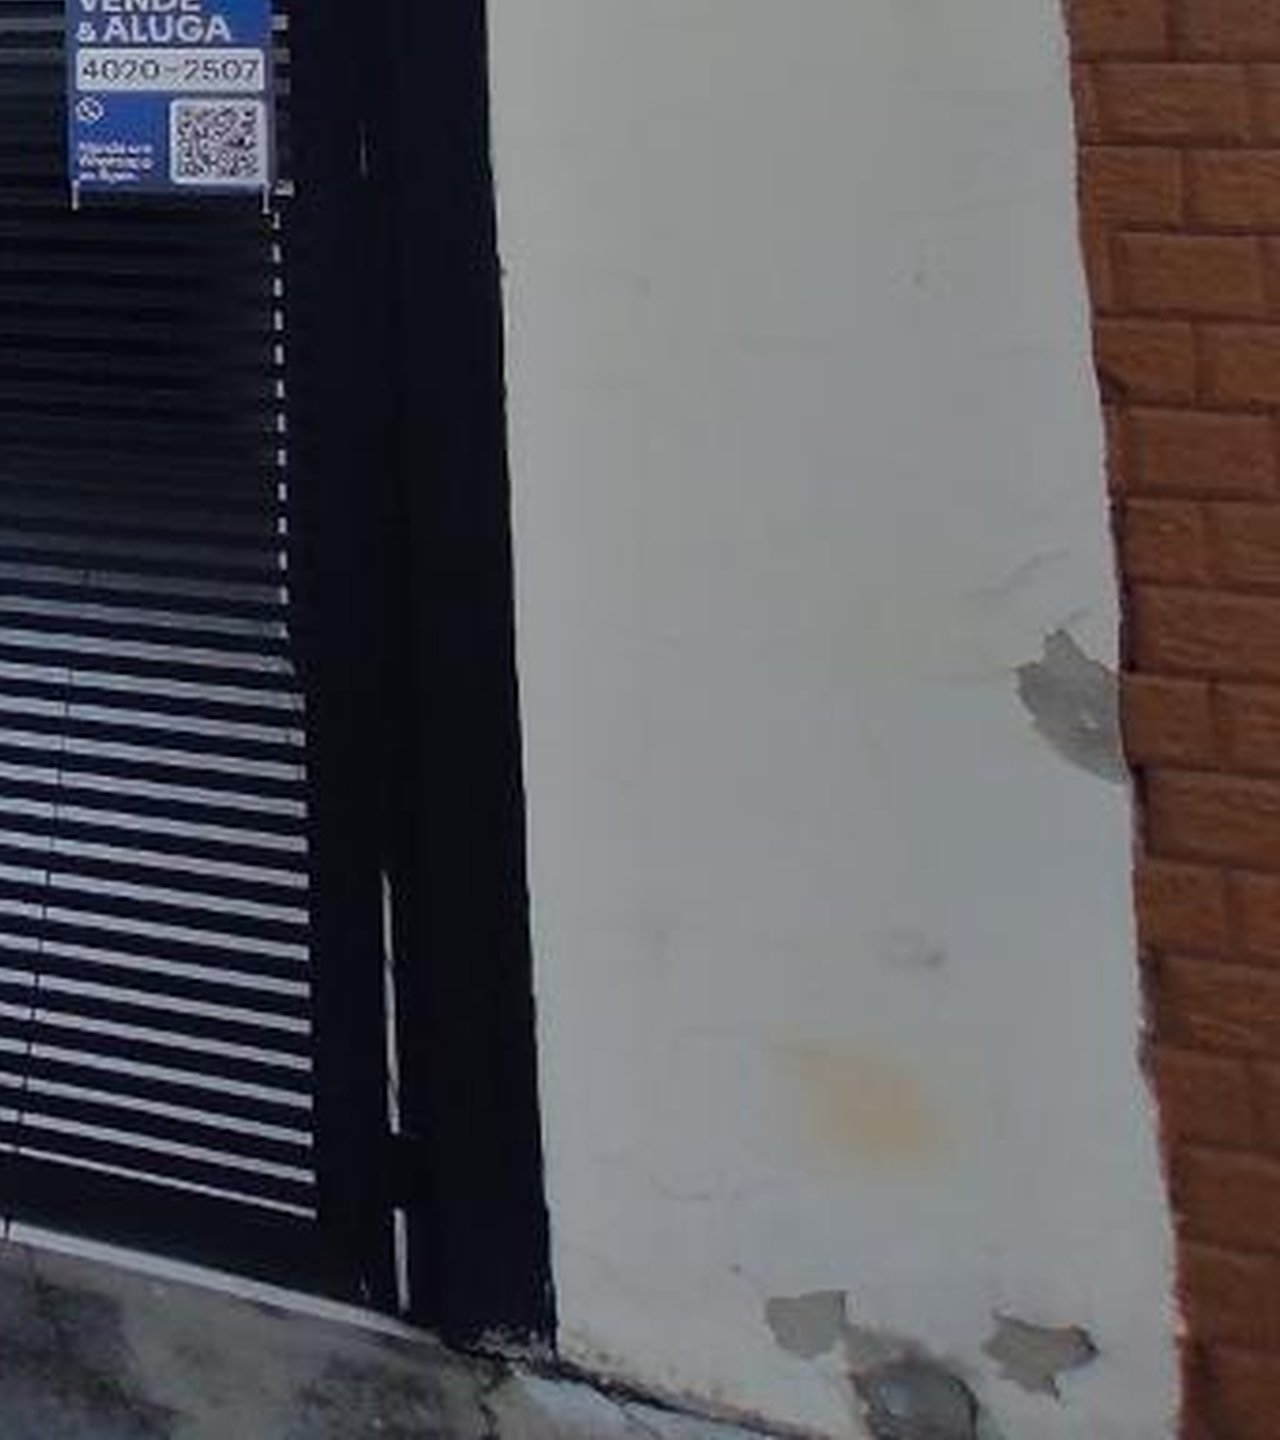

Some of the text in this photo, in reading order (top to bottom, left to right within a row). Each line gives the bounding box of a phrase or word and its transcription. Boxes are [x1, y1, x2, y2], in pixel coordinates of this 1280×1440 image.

[75, 15, 233, 42] & ALUGA
[82, 58, 260, 81] 4020-2507
